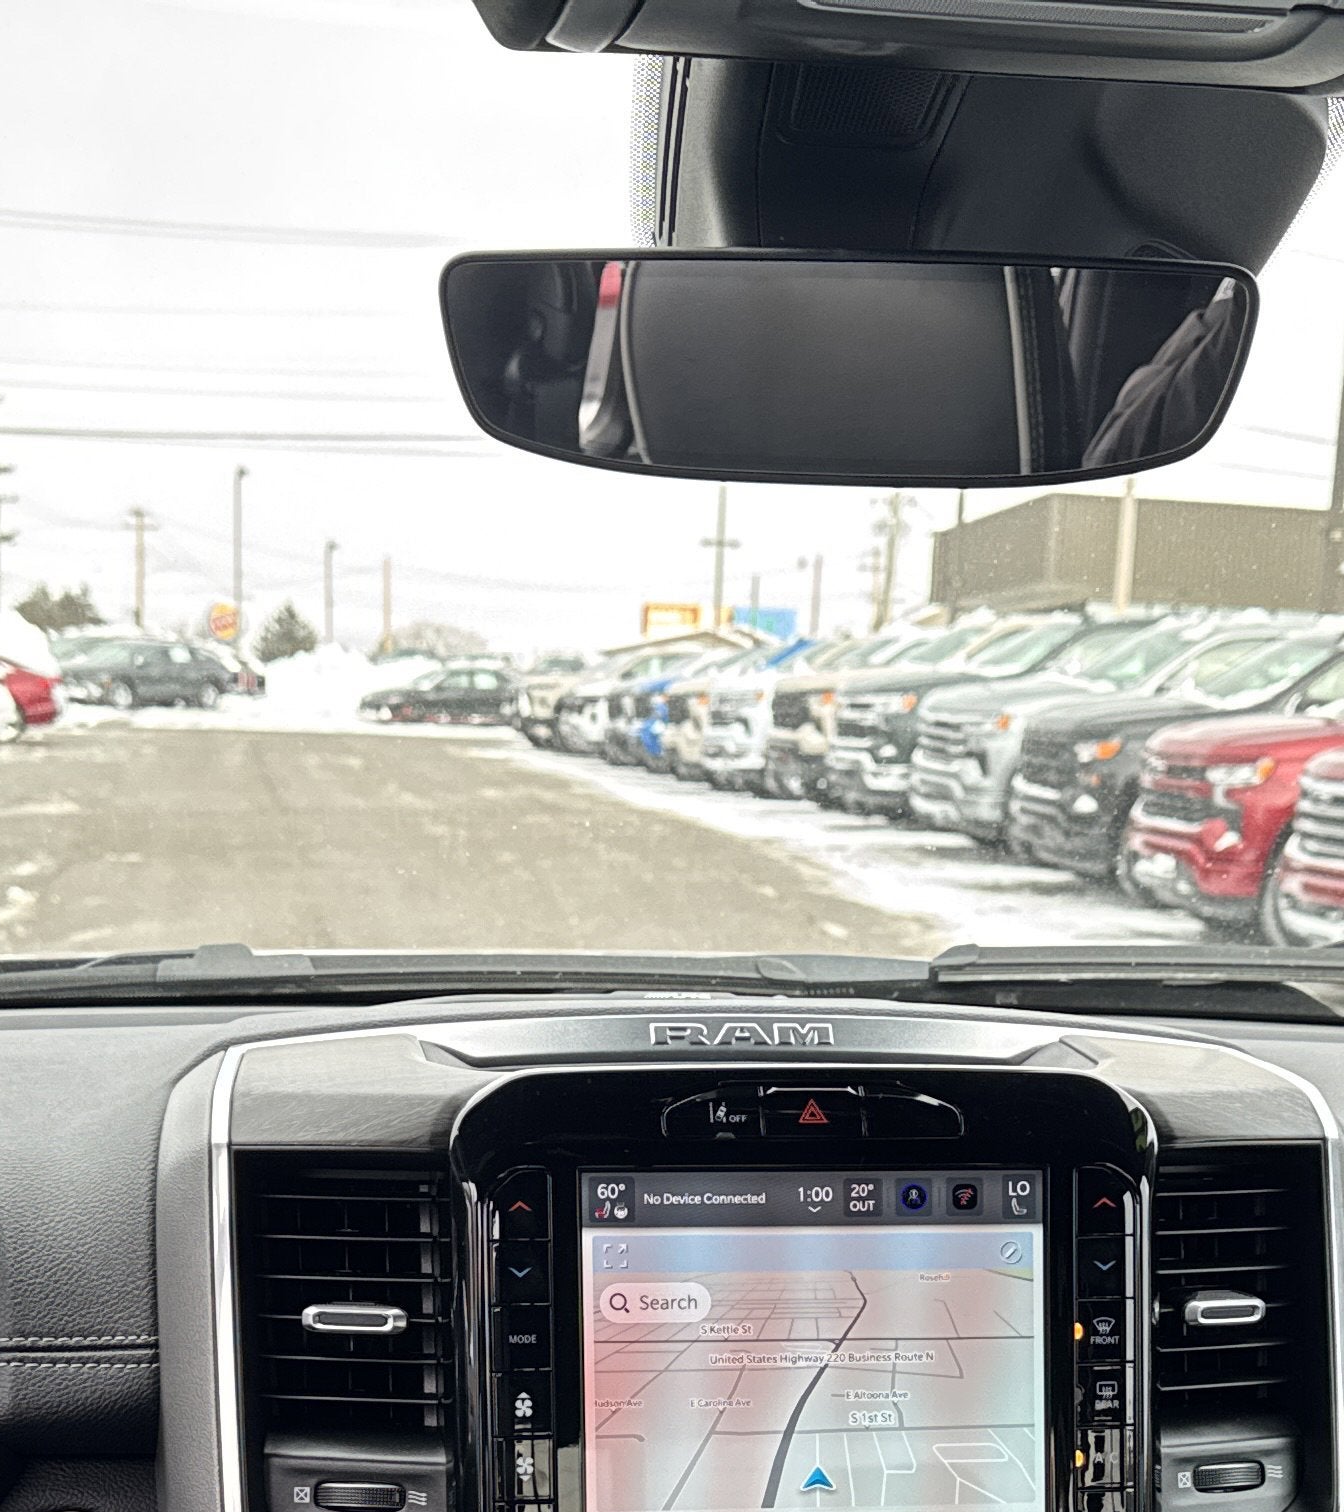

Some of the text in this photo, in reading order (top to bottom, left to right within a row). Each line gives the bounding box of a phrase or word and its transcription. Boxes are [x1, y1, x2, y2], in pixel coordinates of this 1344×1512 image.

[649, 1022, 834, 1046] RAM
[729, 1115, 748, 1123] OFF
[597, 1183, 626, 1200] 60°
[798, 1186, 833, 1203] 1:00
[850, 1184, 875, 1198] 20°
[1008, 1181, 1030, 1197] LO
[644, 1192, 766, 1205] No Device Connected
[849, 1200, 875, 1213] OUT
[639, 1294, 698, 1311] Search
[700, 1325, 753, 1336] S Kettle St
[508, 1334, 537, 1344] MODE
[1090, 1335, 1120, 1345] FRONT
[710, 1352, 934, 1367] United States Highway 220 Business Route N
[846, 1390, 909, 1400] E Altoona Ave
[690, 1400, 695, 1408] E
[735, 1399, 752, 1407] Ave
[850, 1411, 893, 1424] S 1st St
